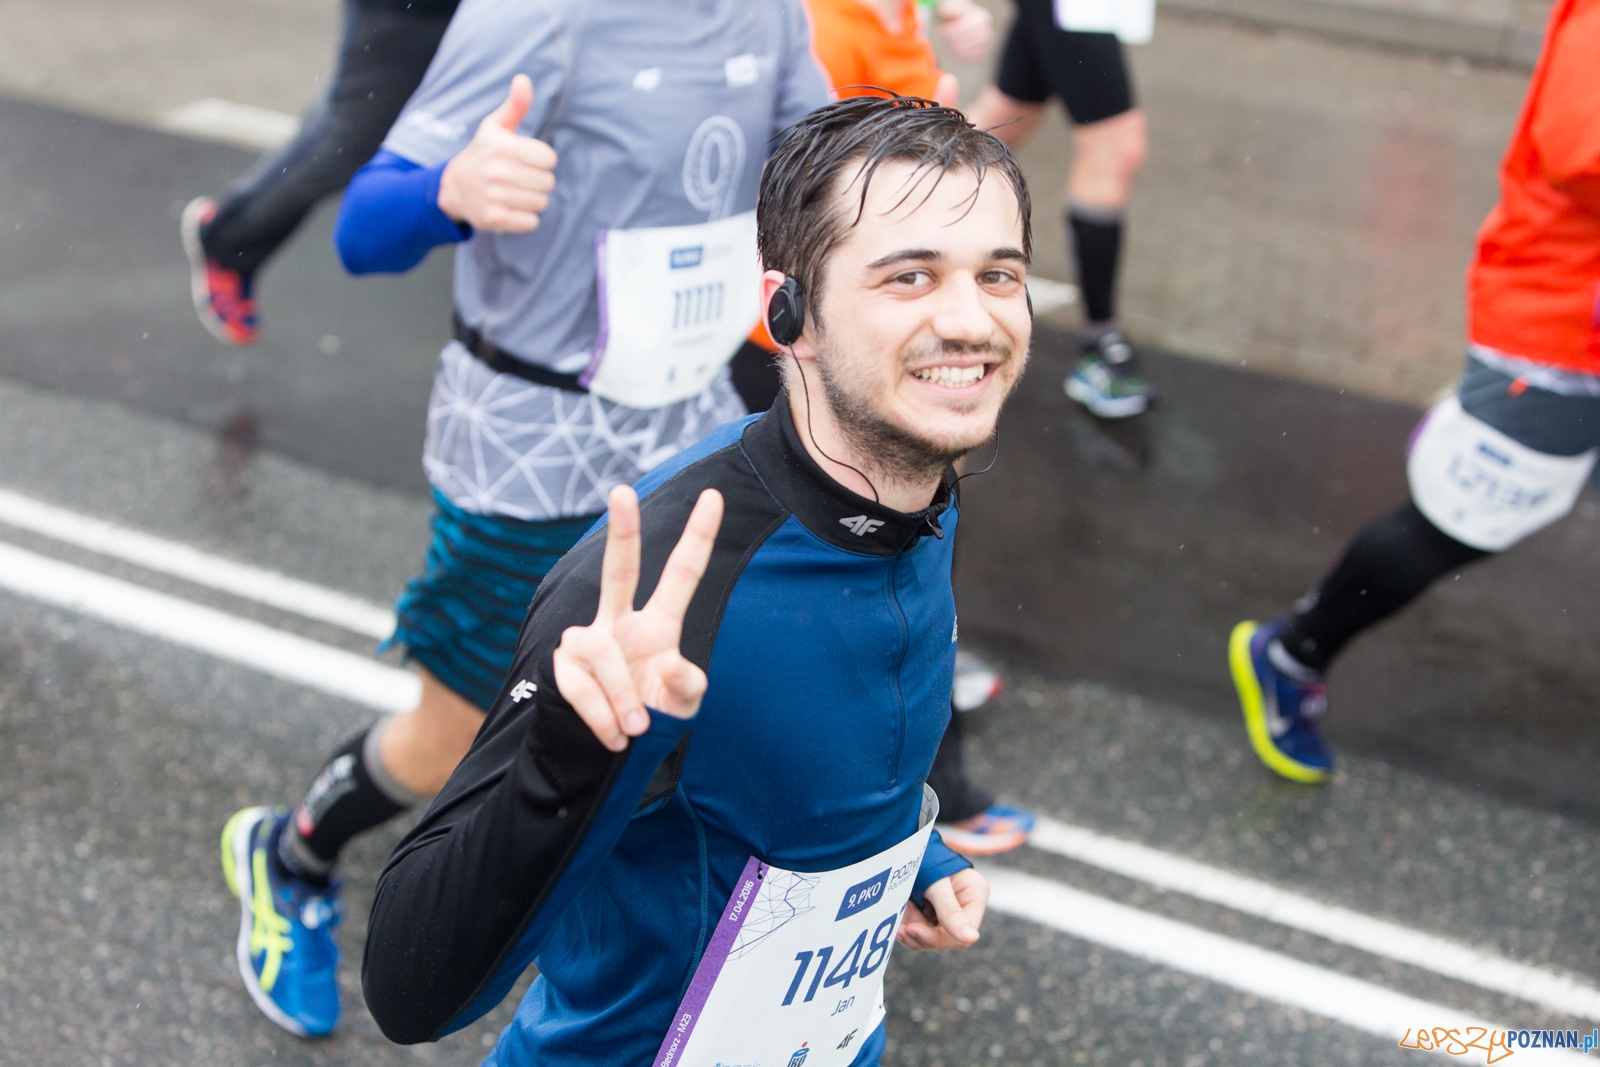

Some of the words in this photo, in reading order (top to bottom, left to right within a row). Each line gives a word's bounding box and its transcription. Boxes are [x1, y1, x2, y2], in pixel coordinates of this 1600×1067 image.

[671, 280, 725, 331] 11111
[838, 514, 886, 537] 4F
[510, 679, 538, 703] 4F
[728, 879, 755, 922] 17.04.2016
[846, 893, 858, 909] 9.
[857, 881, 882, 905] PKO
[780, 901, 908, 1007] 1148
[830, 995, 855, 1017] Jan
[660, 1037, 681, 1067] Bednorz
[676, 1013, 692, 1033] M23
[836, 1028, 858, 1051] 4F
